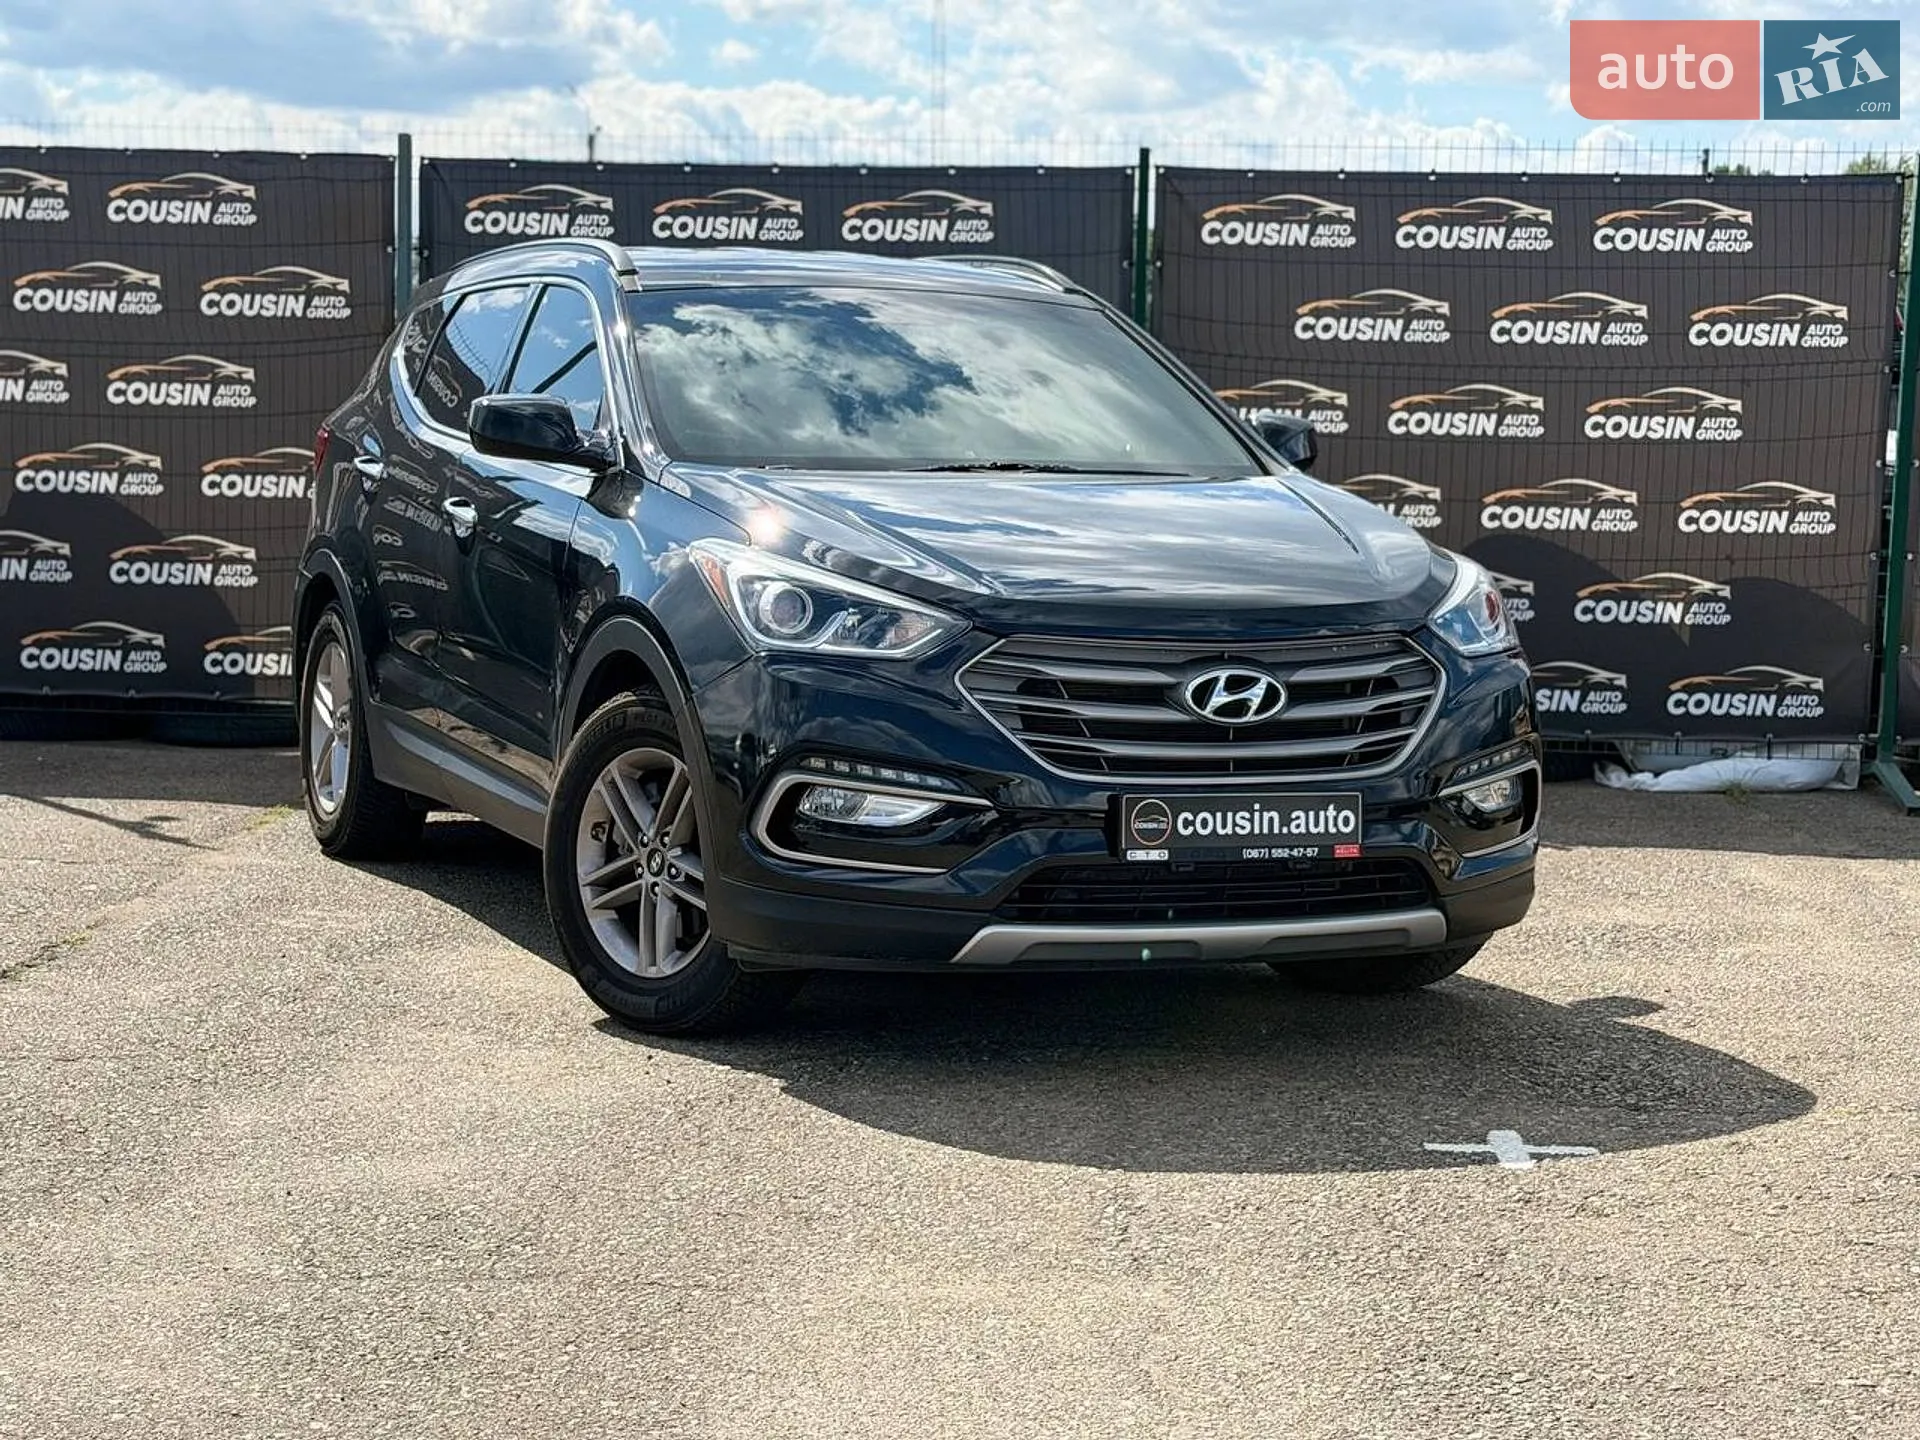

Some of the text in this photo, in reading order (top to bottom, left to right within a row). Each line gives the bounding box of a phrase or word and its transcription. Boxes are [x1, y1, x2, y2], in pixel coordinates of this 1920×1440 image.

[0, 197, 25, 220] IN
[30, 198, 65, 210] AUTO
[217, 203, 252, 214] AUTO
[26, 209, 70, 221] GROUP
[107, 199, 212, 223] COUSIN
[213, 214, 257, 225] GROUP
[465, 211, 569, 236] COUSIN
[574, 215, 609, 226] AUTO
[763, 218, 798, 230] AUTO
[653, 216, 757, 239] COUSIN
[842, 218, 947, 241] COUSIN
[953, 220, 988, 232] AUTO
[1316, 224, 1352, 237] AUTO
[568, 226, 614, 239] GROUP
[756, 229, 803, 241] GROUP
[946, 231, 994, 242] GROUP
[1201, 221, 1310, 246] COUSIN
[1396, 225, 1506, 249] COUSIN
[1512, 227, 1548, 240] AUTO
[1710, 229, 1748, 242] AUTO
[1310, 236, 1356, 247] GROUP
[1506, 239, 1553, 250] GROUP
[1593, 228, 1705, 251] COUSIN
[1706, 241, 1753, 252] GROUP
[13, 288, 119, 312] COUSIN
[124, 292, 157, 303] AUTO
[311, 296, 346, 308] AUTO
[118, 303, 162, 314] GROUP
[200, 293, 307, 317] COUSIN
[306, 308, 351, 318] GROUP
[1295, 317, 1405, 341] COUSIN
[1409, 320, 1446, 333] AUTO
[1490, 320, 1601, 344] COUSIN
[1607, 323, 1643, 335] AUTO
[1806, 324, 1843, 337] AUTO
[1404, 331, 1450, 342] GROUP
[1601, 334, 1648, 345] GROUP
[1689, 323, 1801, 346] COUSIN
[1801, 336, 1848, 347] GROUP
[0, 378, 25, 402] IN
[30, 380, 64, 392] AUTO
[218, 385, 252, 396] AUTO
[25, 391, 70, 403] GROUP
[107, 382, 211, 405] COUSIN
[212, 396, 257, 407] GROUP
[1307, 410, 1344, 421] AUTO
[1503, 414, 1539, 427] AUTO
[1388, 411, 1499, 435] COUSIN
[1584, 415, 1697, 439] COUSIN
[1701, 417, 1737, 430] AUTO
[1498, 426, 1544, 437] GROUP
[1696, 429, 1743, 440] GROUP
[16, 470, 118, 493] COUSIN
[125, 473, 159, 485] AUTO
[120, 484, 164, 495] GROUP
[201, 474, 306, 498] COUSIN
[1401, 504, 1436, 516] AUTO
[1597, 509, 1633, 520] AUTO
[1481, 506, 1591, 530] COUSIN
[1678, 509, 1790, 533] COUSIN
[1794, 511, 1830, 524] AUTO
[1591, 520, 1638, 531] GROUP
[1789, 523, 1836, 534] GROUP
[0, 558, 28, 581] IN
[34, 560, 67, 571] AUTO
[219, 565, 253, 576] AUTO
[29, 570, 73, 582] GROUP
[110, 561, 213, 584] COUSIN
[214, 575, 258, 587] GROUP
[1575, 600, 1685, 623] COUSIN
[1690, 603, 1726, 614] AUTO
[1684, 614, 1731, 625] GROUP
[20, 647, 122, 671] COUSIN
[129, 651, 162, 662] AUTO
[123, 662, 167, 672] GROUP
[204, 652, 292, 676] COUSI
[1535, 688, 1581, 713] SIN
[1586, 691, 1622, 703] AUTO
[1782, 695, 1818, 706] AUTO
[1581, 702, 1627, 714] GROUP
[1667, 693, 1777, 716] COUSIN
[1777, 705, 1824, 717] GROUP
[1177, 803, 1356, 836] cousin.auto
